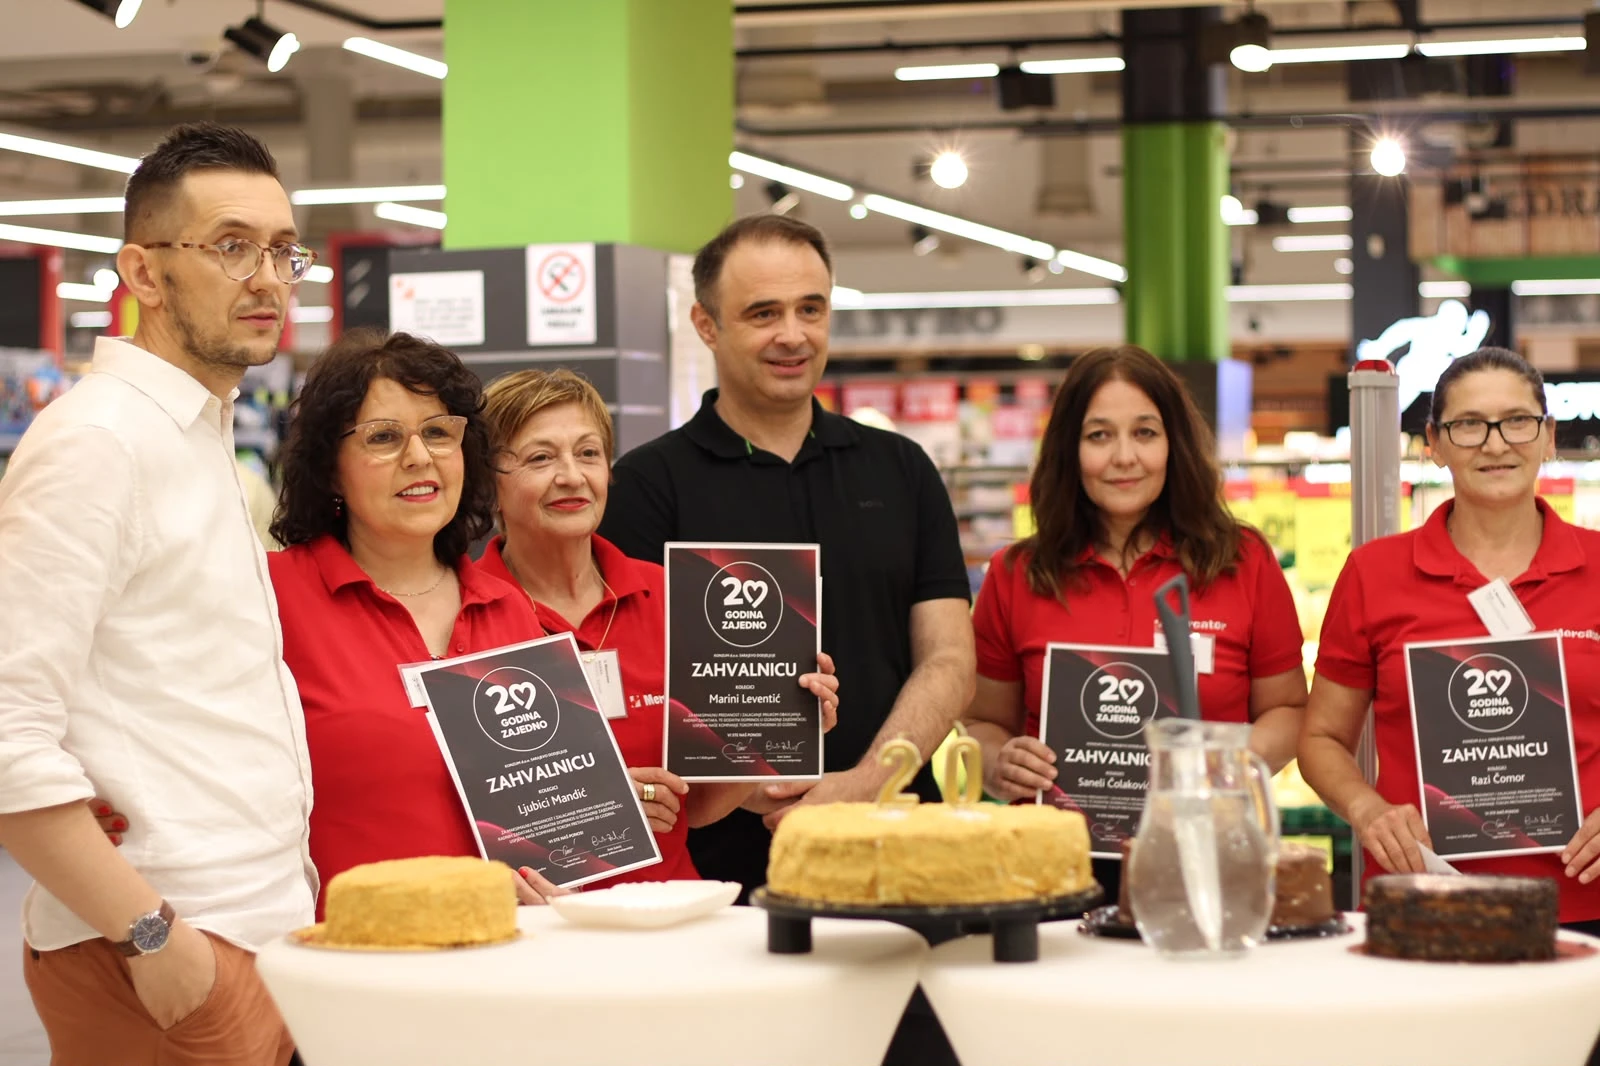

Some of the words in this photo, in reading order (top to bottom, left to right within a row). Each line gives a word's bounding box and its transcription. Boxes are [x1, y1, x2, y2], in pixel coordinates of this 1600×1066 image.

[725, 610, 763, 619] GODINA
[722, 621, 766, 629] ZAJEDNO
[692, 663, 796, 676] ZAHVALNICU
[710, 694, 738, 703] Marini
[742, 694, 780, 703] Leventić
[1470, 697, 1509, 708] GODINA
[1100, 704, 1137, 714] GODINA
[1468, 706, 1513, 717] ZAJEDNO
[501, 711, 541, 727] GODINA
[1096, 713, 1140, 723] ZAJEDNO
[501, 720, 547, 738] ZAJEDNO
[1064, 748, 1152, 766] ZAHVALNIC
[1442, 742, 1547, 763] ZAHVALNICU
[486, 752, 595, 793] ZAHVALNICU
[1471, 775, 1490, 786] Razi
[1492, 770, 1525, 784] Čomor
[1078, 776, 1105, 788] Saneli
[517, 797, 552, 817] Ljubici
[550, 787, 588, 806] Mandić
